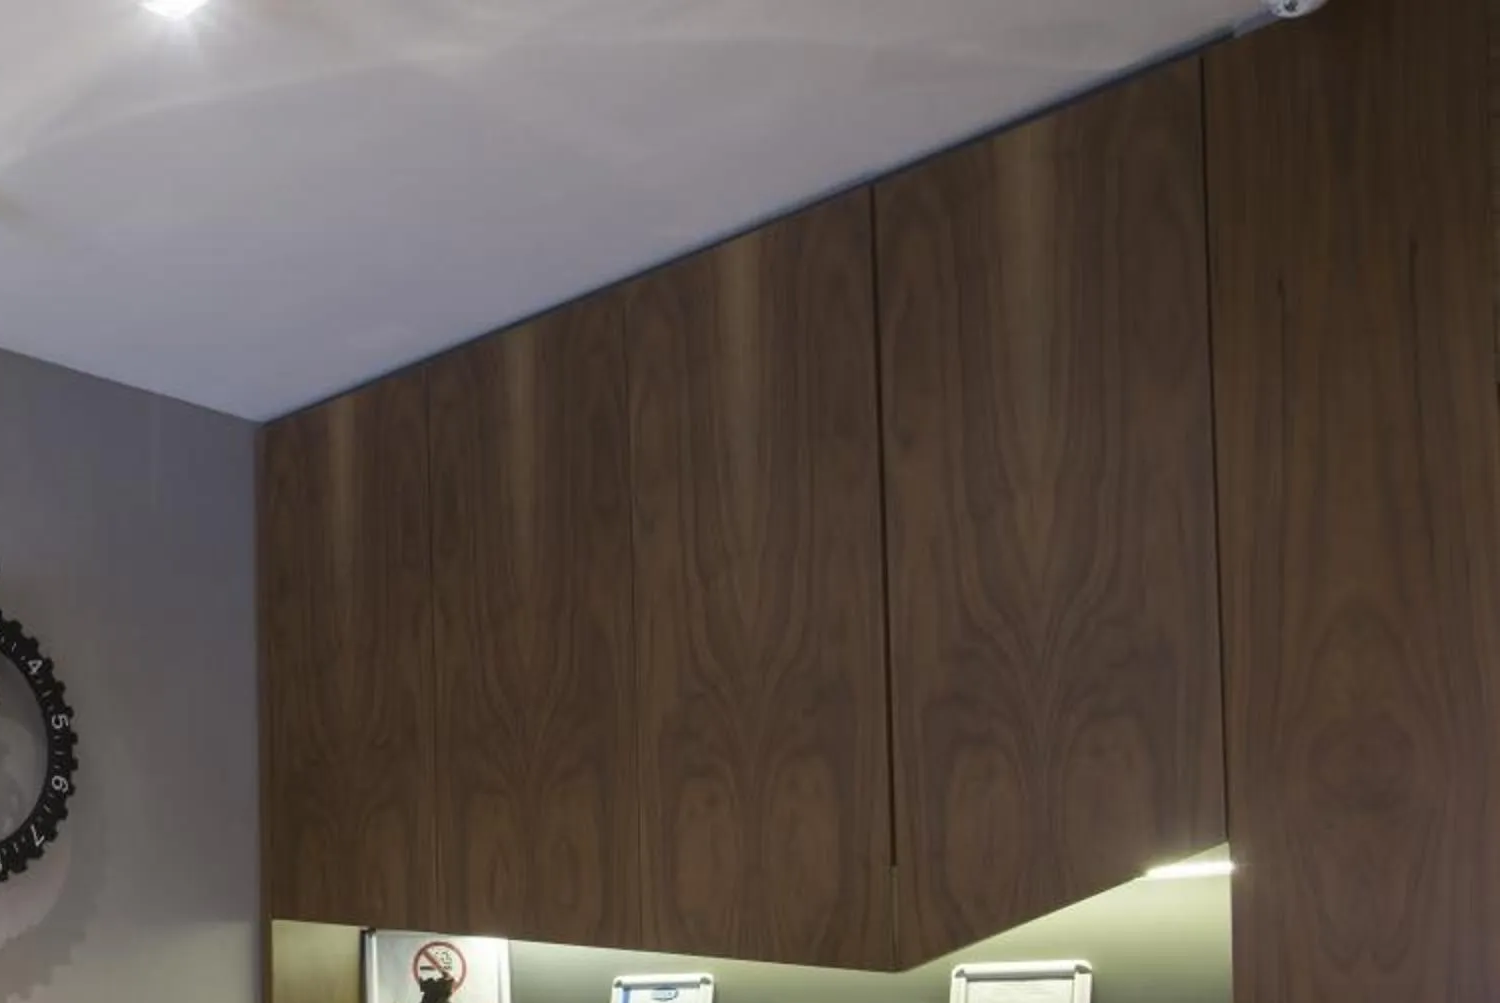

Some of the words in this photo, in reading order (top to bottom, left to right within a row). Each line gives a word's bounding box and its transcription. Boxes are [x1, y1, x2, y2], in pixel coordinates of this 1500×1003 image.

[28, 658, 43, 674] 4
[51, 713, 69, 729] 5
[51, 775, 69, 792] 6
[30, 825, 46, 847] 7
